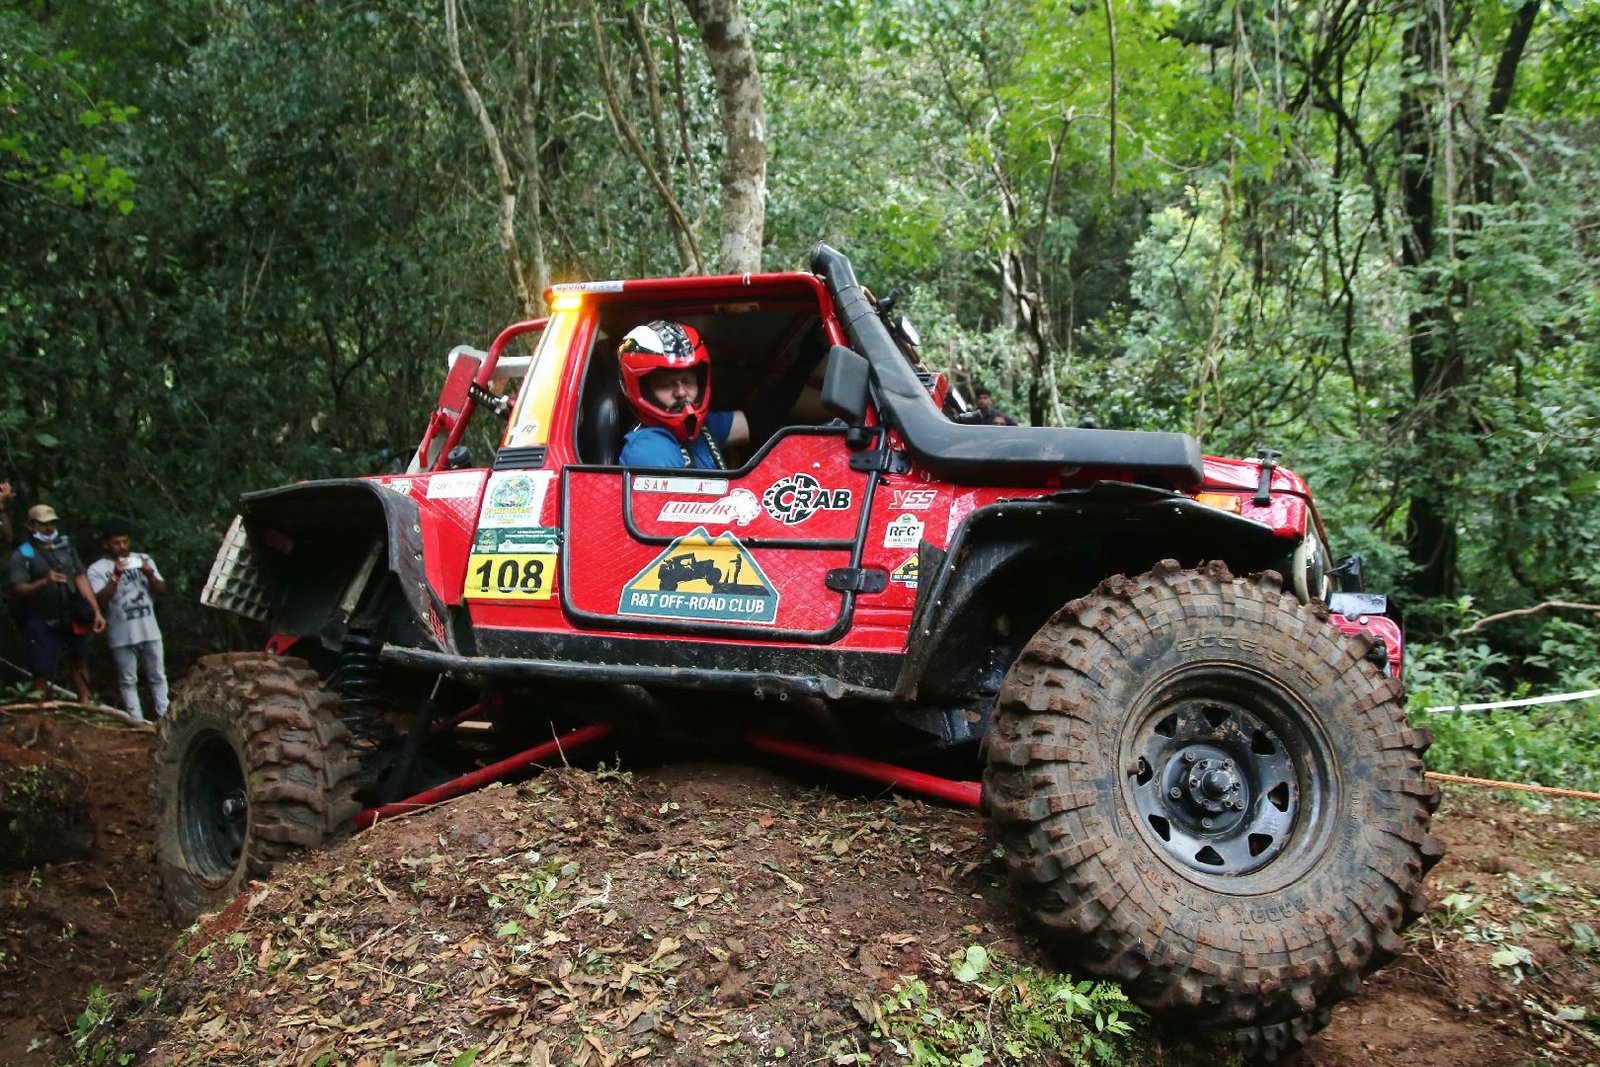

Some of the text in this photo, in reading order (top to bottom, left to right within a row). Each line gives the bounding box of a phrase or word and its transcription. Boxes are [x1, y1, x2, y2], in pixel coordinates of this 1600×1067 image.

[643, 479, 669, 491] SAM
[773, 482, 851, 514] CRAB
[888, 490, 938, 509] YSS
[662, 502, 732, 515] COUGAR
[889, 525, 917, 537] RFC
[475, 559, 544, 594] 108
[630, 592, 765, 614] R&T OFF-ROAD CLUB
